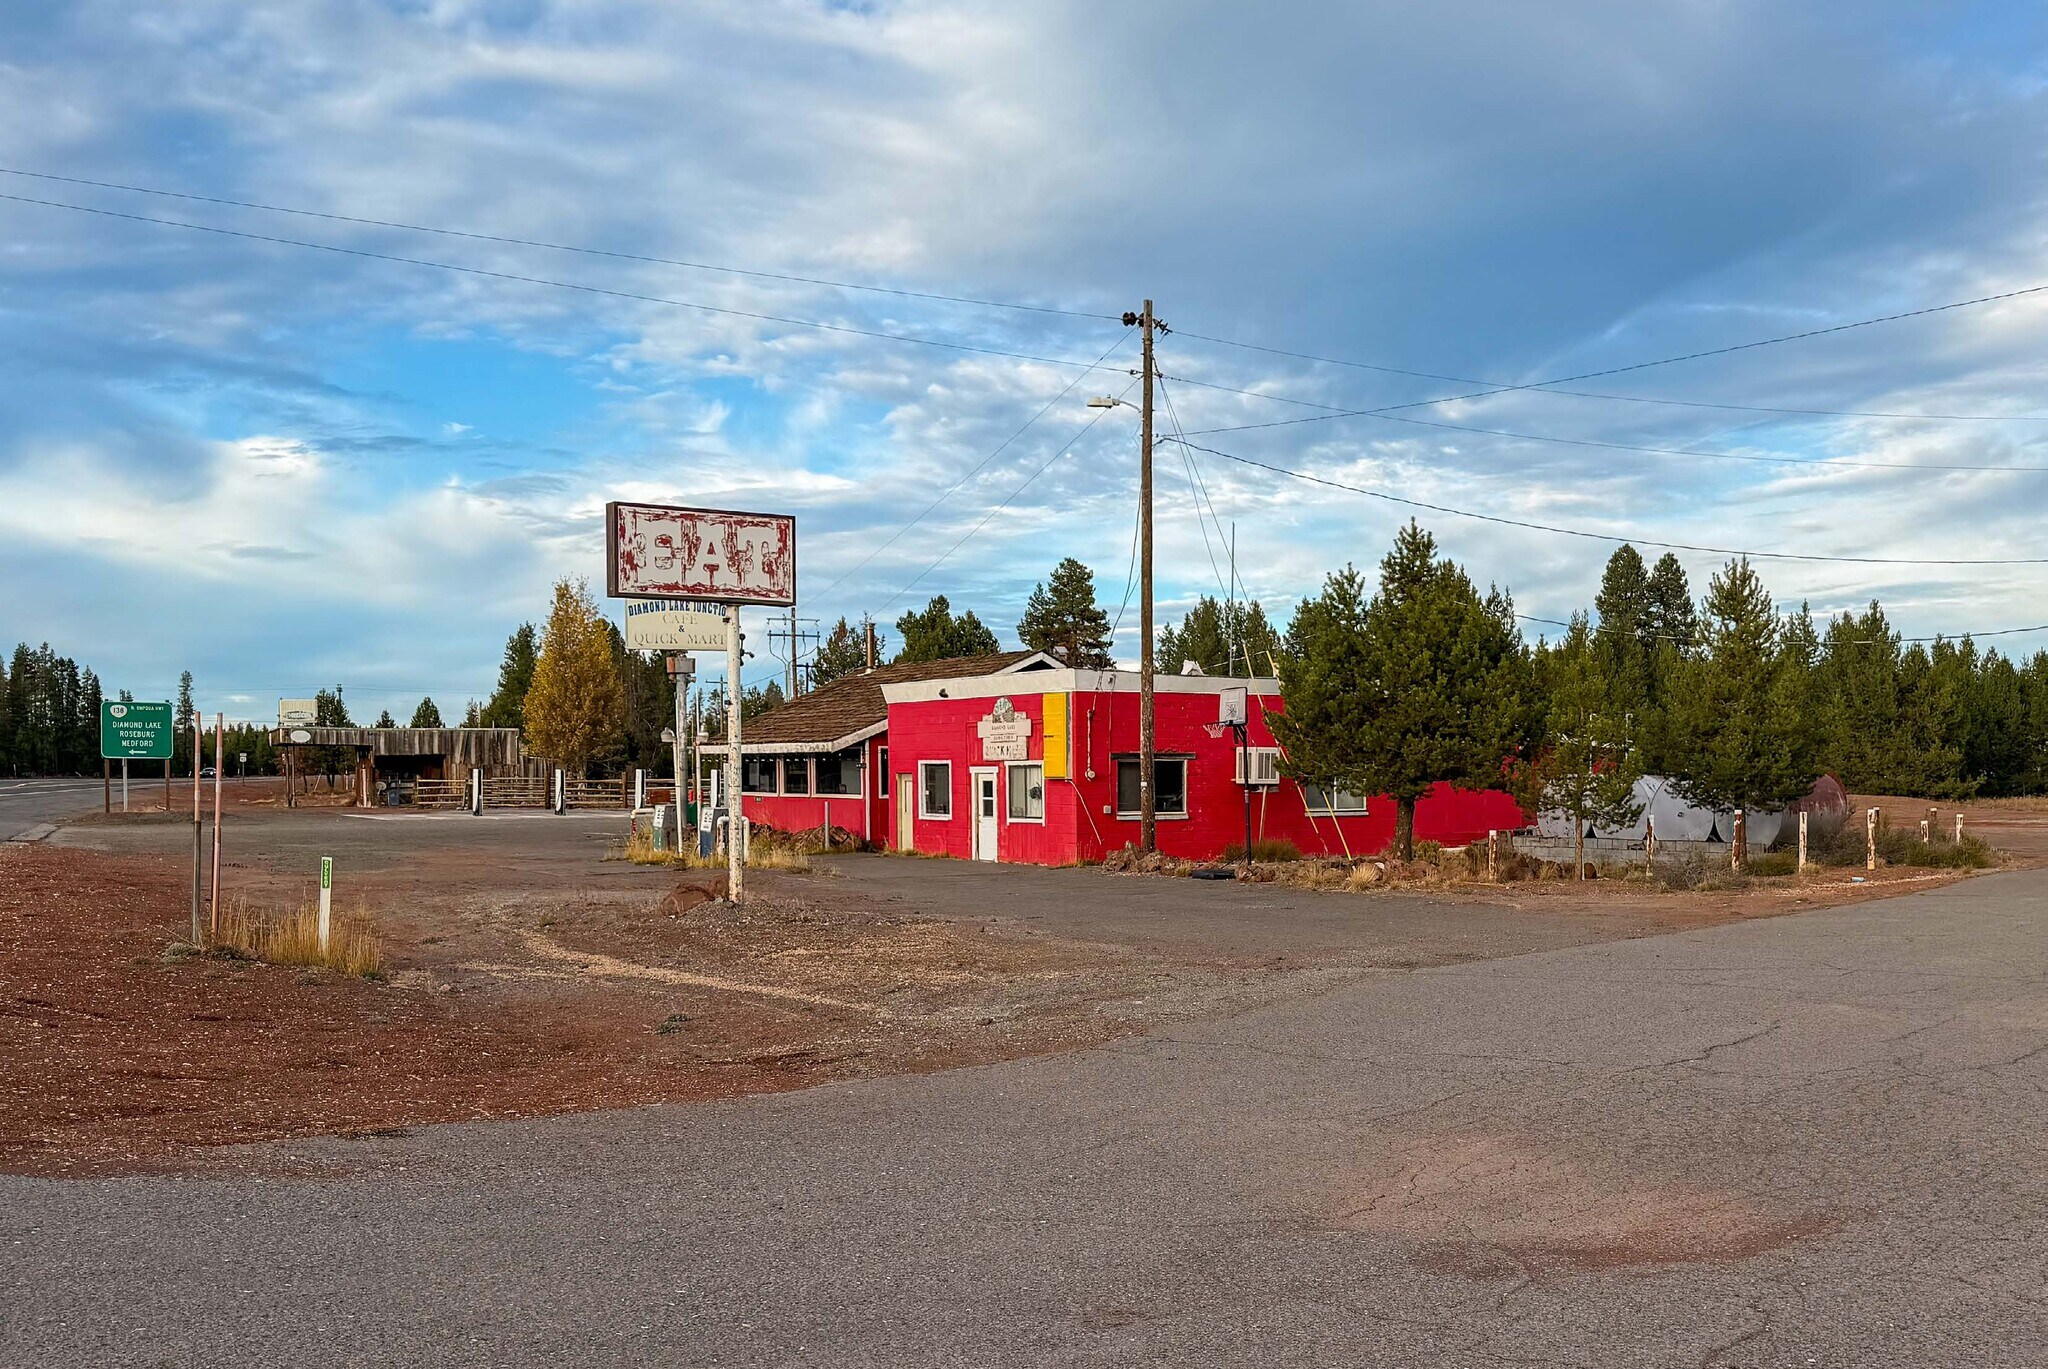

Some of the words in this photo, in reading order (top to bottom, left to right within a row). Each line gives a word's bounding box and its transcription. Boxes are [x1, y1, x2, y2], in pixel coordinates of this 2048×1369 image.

[635, 517, 780, 591] EAT
[628, 601, 666, 616] DIAMOND
[669, 600, 690, 612] LAKE
[693, 600, 727, 617] JUNCTIO
[662, 613, 699, 626] CAFE
[678, 624, 685, 633] &
[634, 633, 679, 646] QUICK
[687, 634, 727, 645] MART
[119, 730, 155, 738] ROSEBURG
